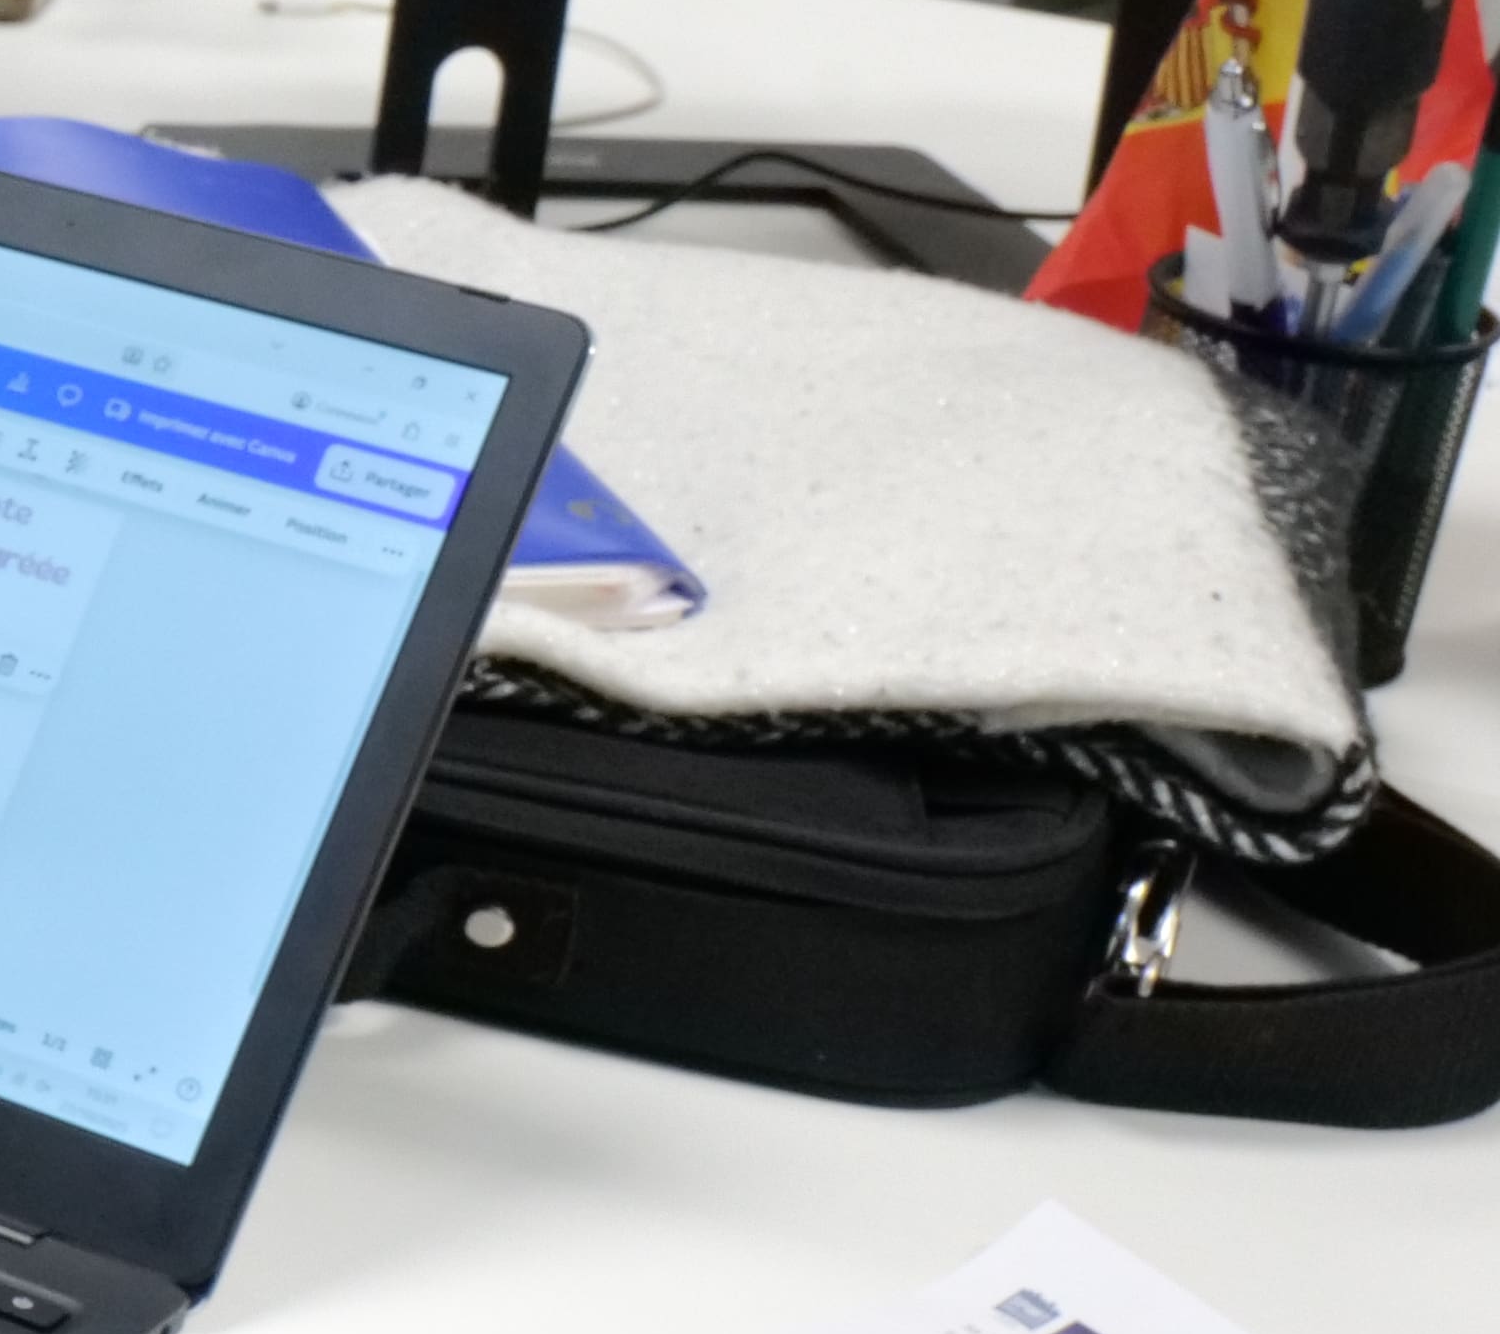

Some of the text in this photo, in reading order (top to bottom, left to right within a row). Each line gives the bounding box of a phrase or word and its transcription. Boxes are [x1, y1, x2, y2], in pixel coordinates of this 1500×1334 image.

[119, 469, 165, 493] Effets
[361, 471, 432, 504] Partager
[195, 490, 252, 518] Animer
[284, 515, 350, 545] Position
[39, 1030, 69, 1052] 1/1
